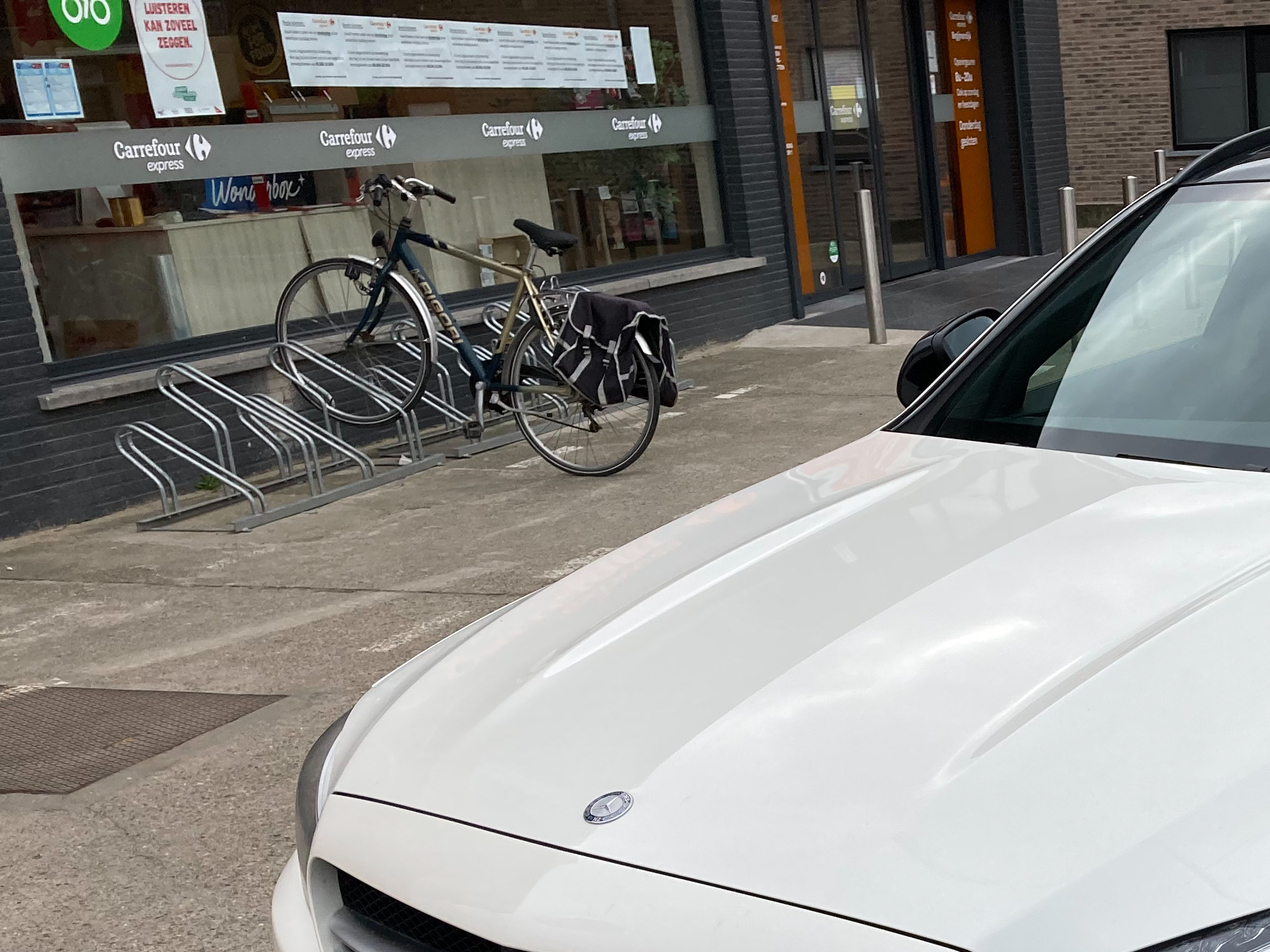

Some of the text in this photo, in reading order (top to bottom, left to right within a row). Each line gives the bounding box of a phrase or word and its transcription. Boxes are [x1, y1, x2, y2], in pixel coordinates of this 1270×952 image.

[143, 2, 191, 15] LUISTEREN
[143, 19, 198, 32] KAN ZOVEEL
[157, 36, 193, 49] ZEGGEN.
[481, 121, 524, 139] Carrefour
[611, 116, 647, 131] Carrefour
[319, 128, 373, 148] Carrefour
[502, 136, 527, 149] express
[113, 138, 181, 160] Carrefour
[345, 146, 376, 160] express
[146, 159, 184, 174] express
